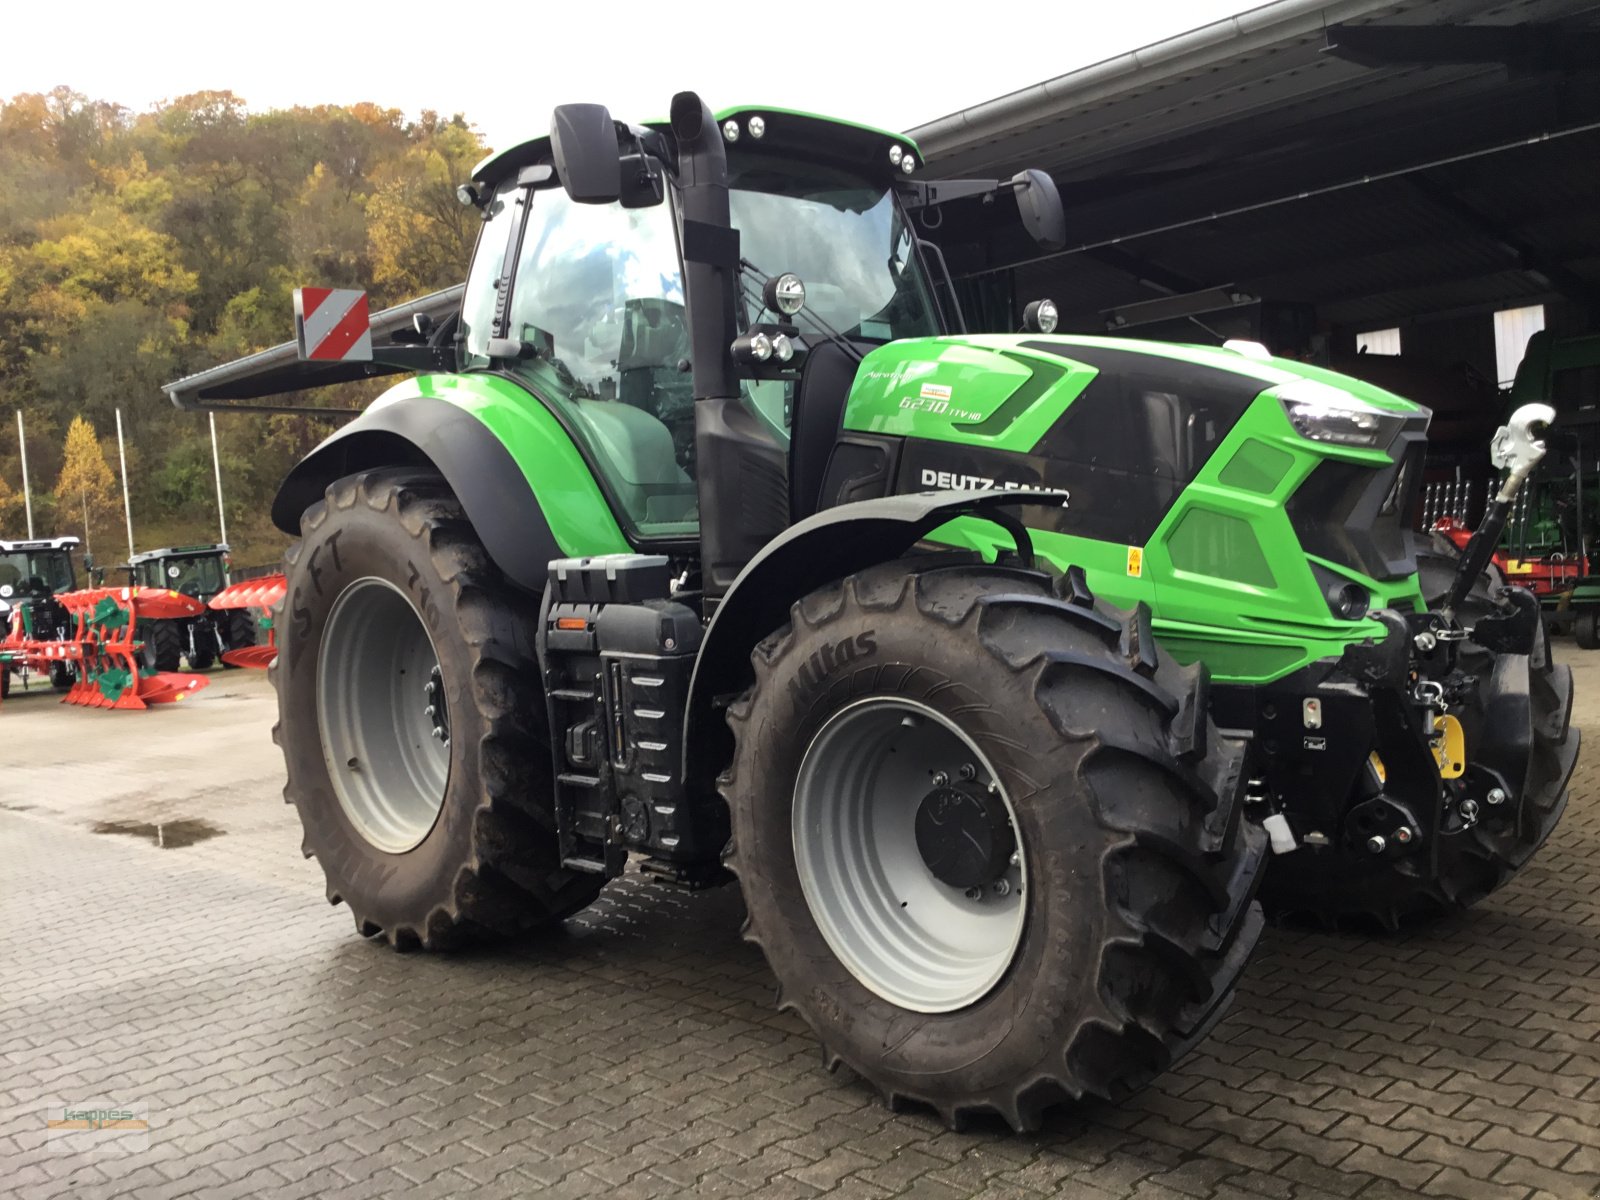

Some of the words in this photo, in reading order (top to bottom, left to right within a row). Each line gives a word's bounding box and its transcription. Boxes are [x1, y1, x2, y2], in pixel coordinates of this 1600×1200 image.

[899, 397, 948, 414] 6230
[968, 412, 982, 421] HD
[786, 628, 878, 706] Mitas
